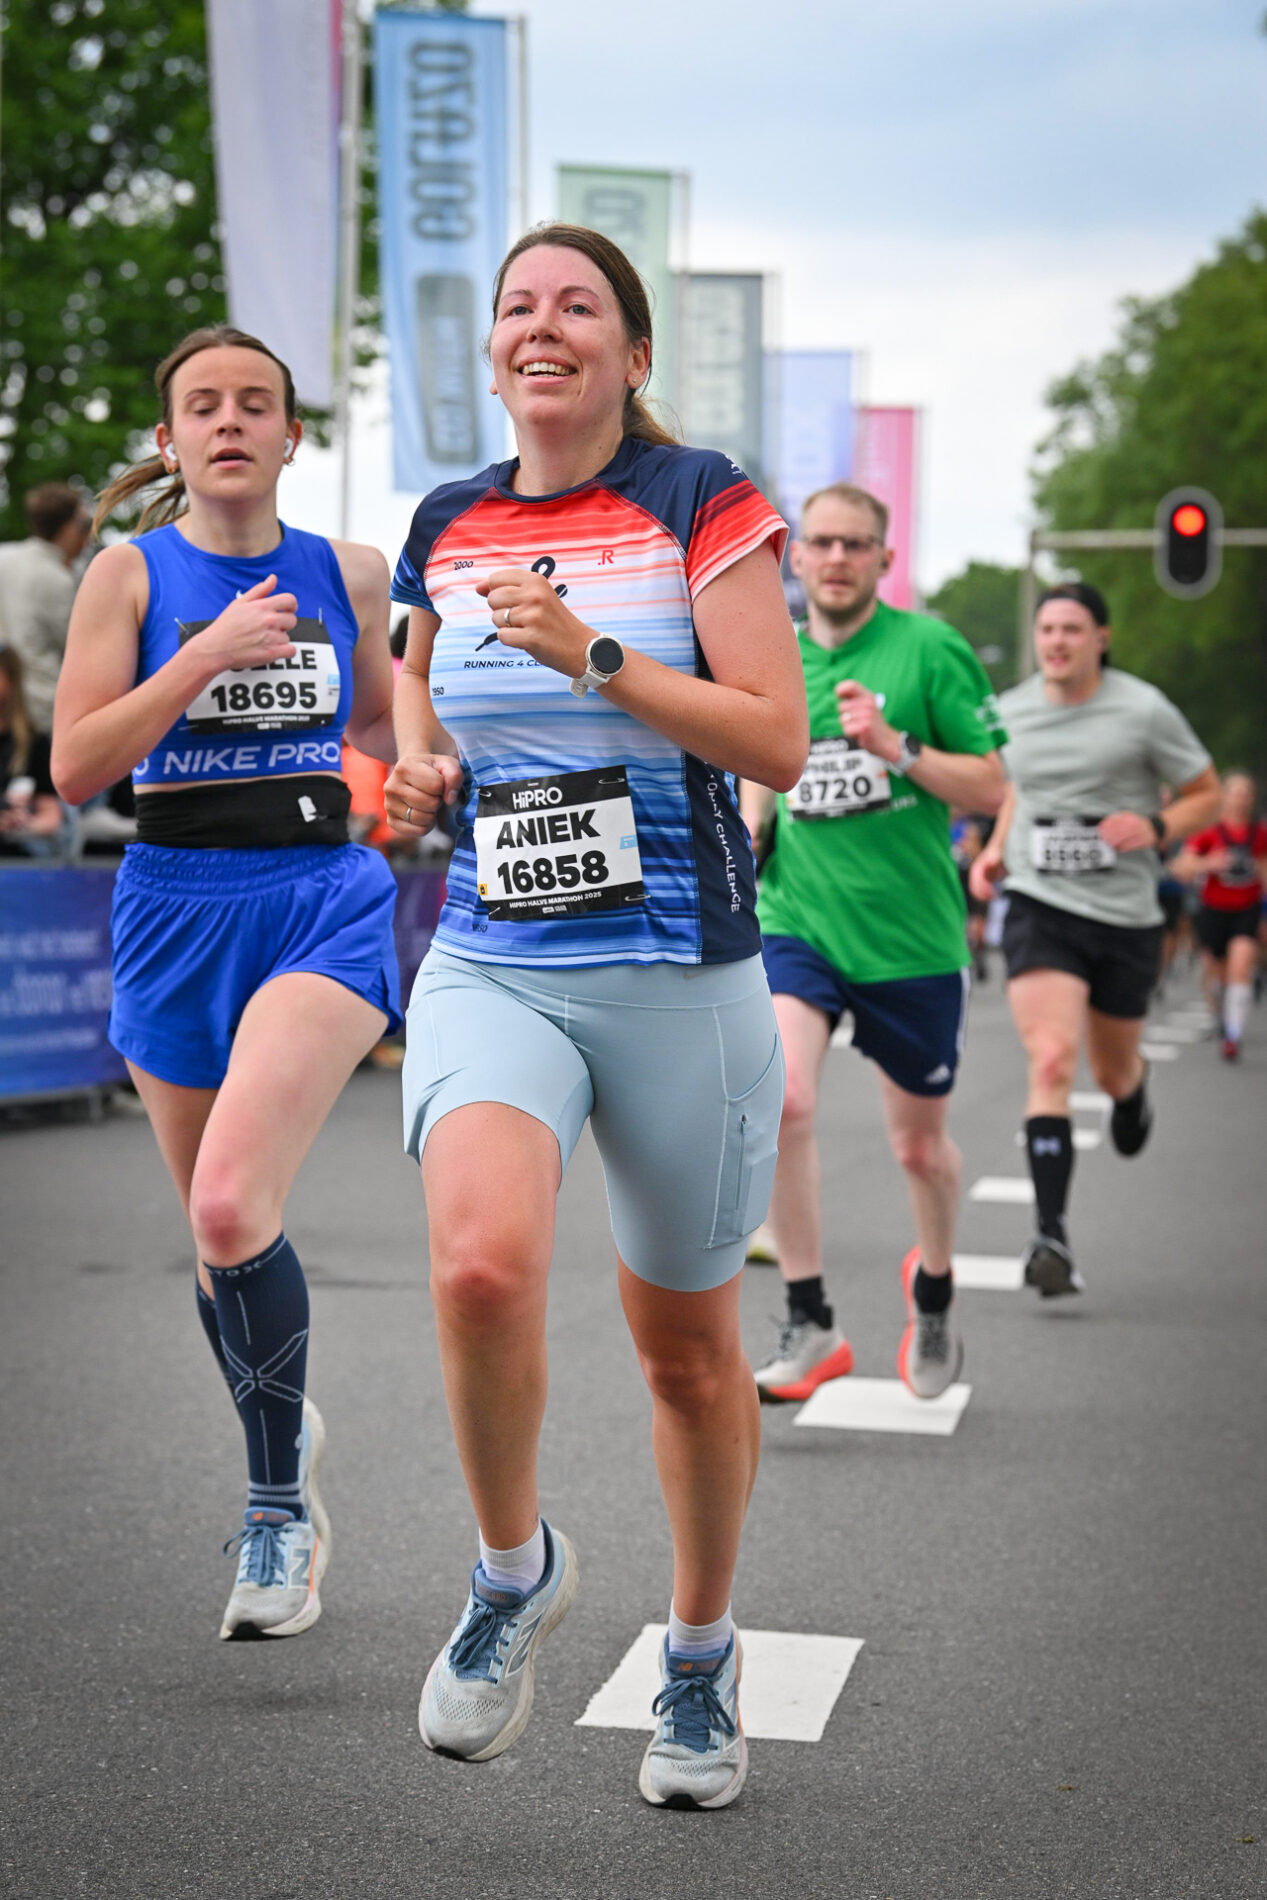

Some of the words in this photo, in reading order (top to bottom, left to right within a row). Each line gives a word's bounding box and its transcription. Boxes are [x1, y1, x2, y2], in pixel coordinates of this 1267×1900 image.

[453, 560, 474, 571] 2000
[463, 660, 514, 669] RUNNING
[210, 681, 317, 713] 18695
[163, 745, 261, 775] NIKE
[268, 741, 341, 768] PRO
[799, 775, 872, 804] 8720
[496, 808, 601, 850] ANIEK
[497, 850, 609, 895] 16858
[716, 823, 741, 913] CHALLENGE
[528, 897, 548, 907] HALVE
[548, 894, 584, 905] MARATHON
[584, 891, 602, 900] 2025
